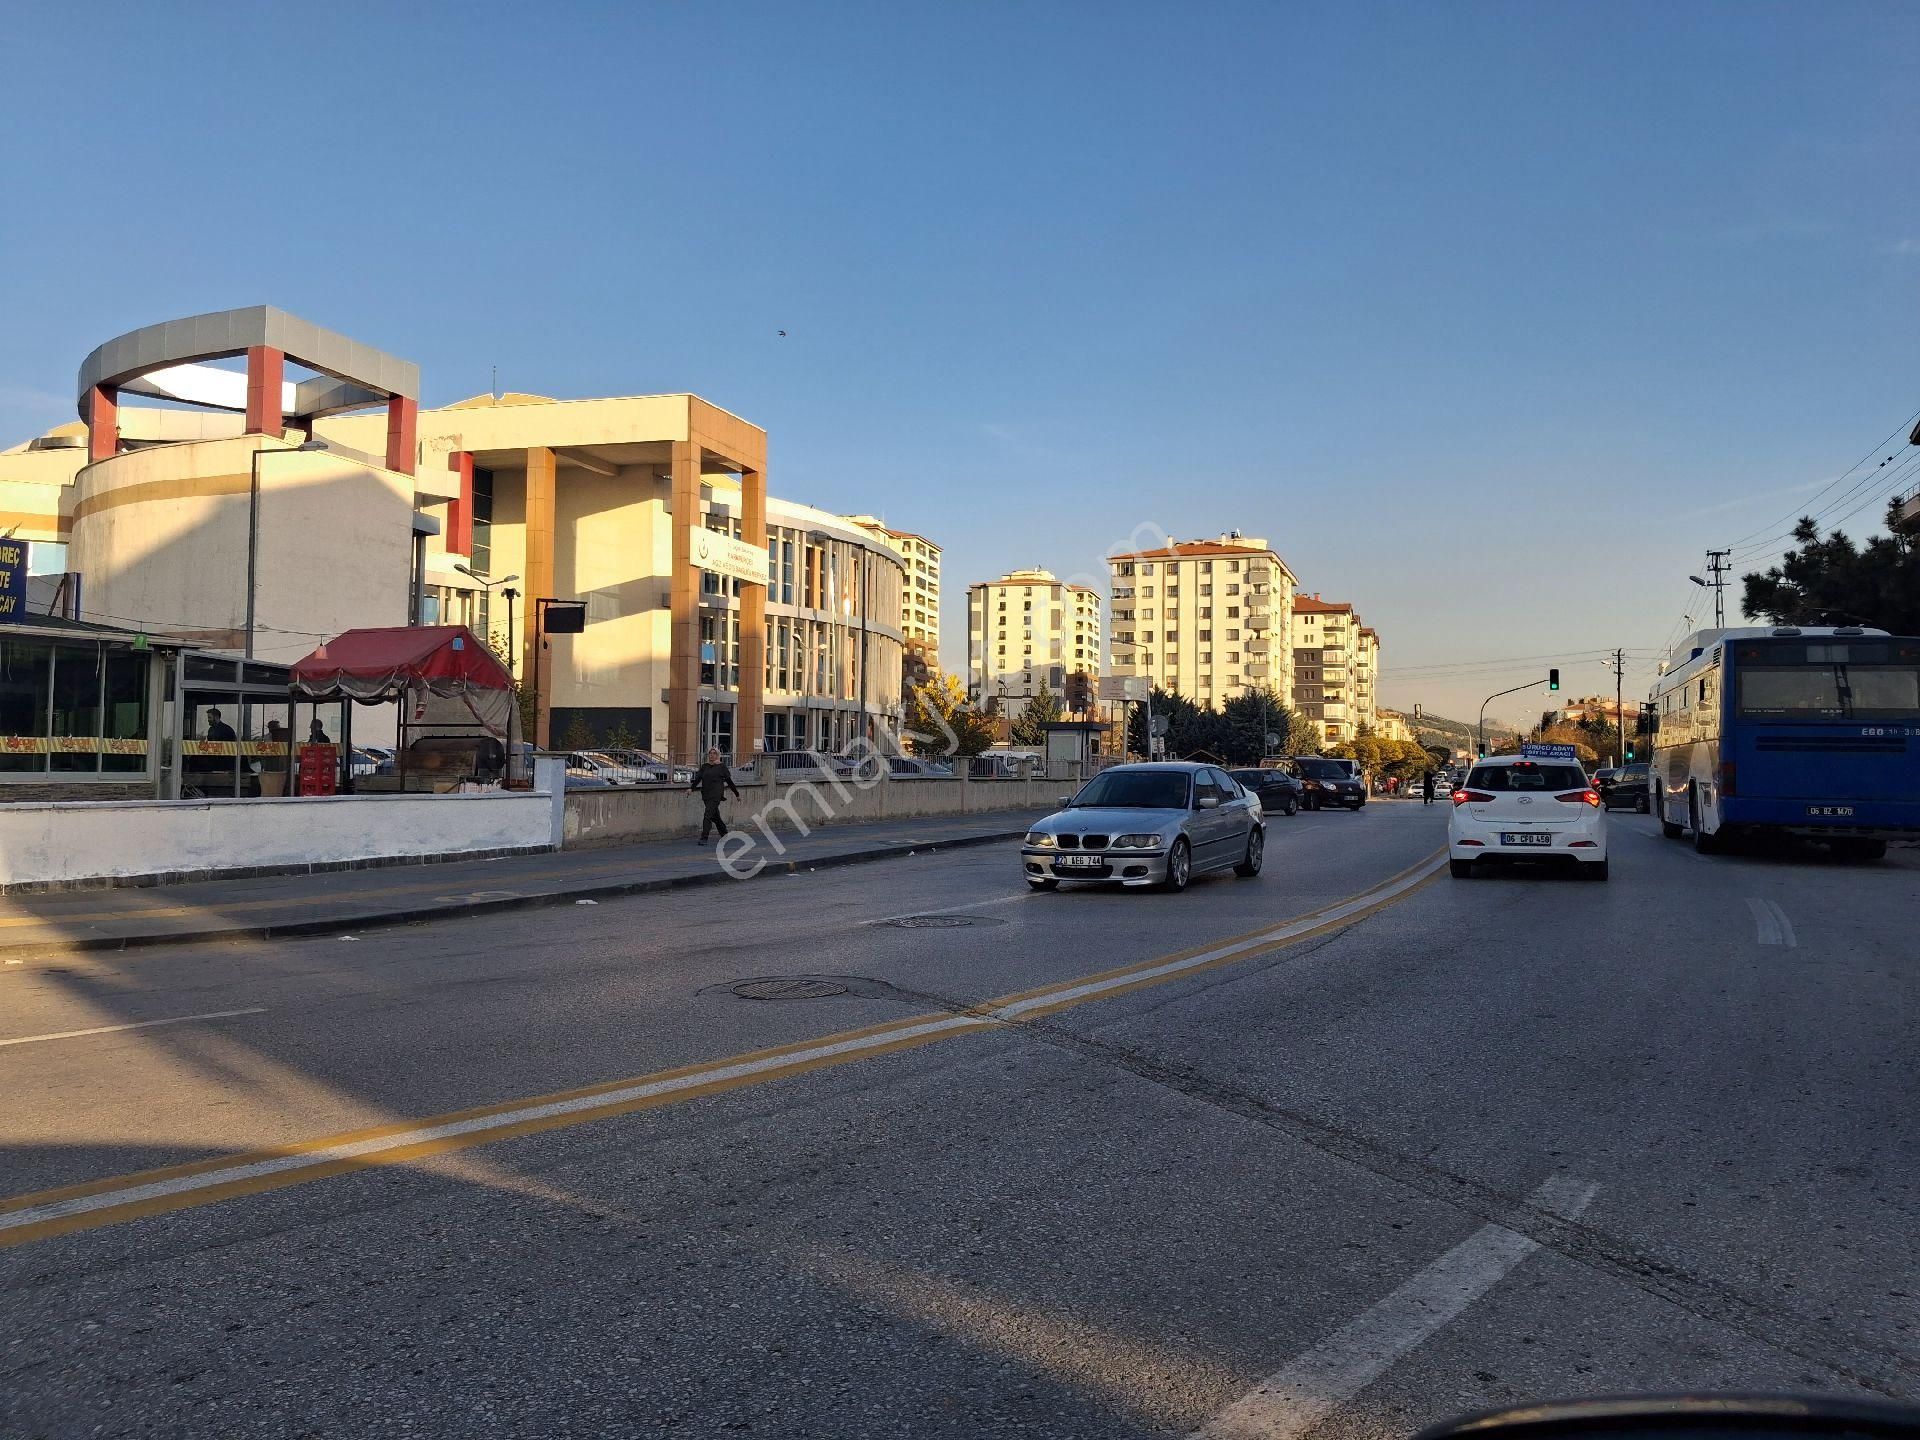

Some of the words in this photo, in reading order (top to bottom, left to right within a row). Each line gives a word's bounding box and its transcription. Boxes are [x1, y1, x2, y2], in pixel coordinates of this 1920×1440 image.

[0, 546, 20, 568] REÇ
[1862, 727, 1883, 736] EGO
[1506, 834, 1516, 842] 06
[1088, 856, 1101, 865] 744
